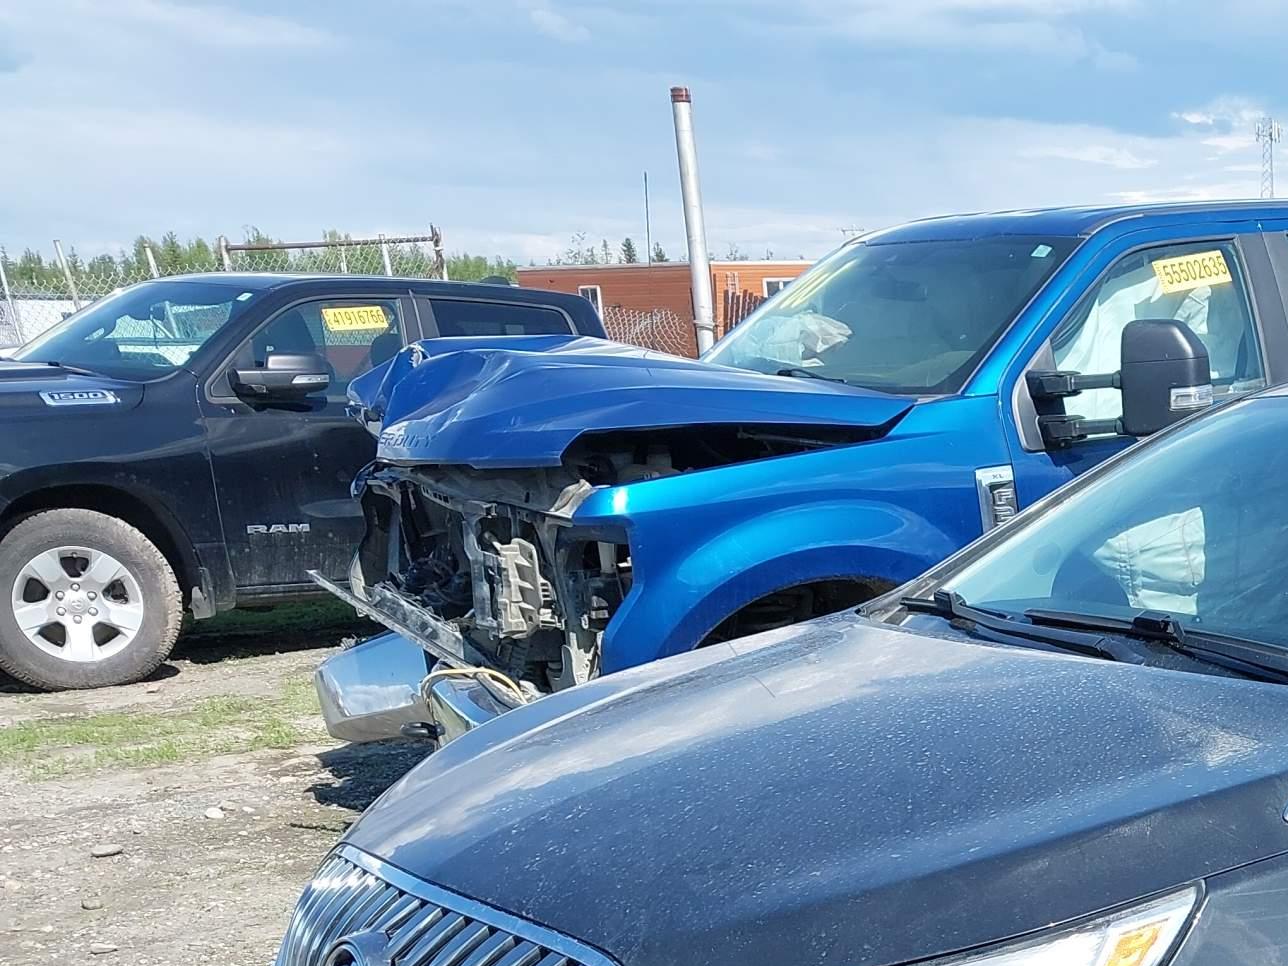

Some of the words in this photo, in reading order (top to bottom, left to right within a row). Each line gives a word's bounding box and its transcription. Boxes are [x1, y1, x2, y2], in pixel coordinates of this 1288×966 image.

[1163, 255, 1228, 285] 55502635
[49, 391, 103, 400] 1500
[246, 523, 310, 534] RAM
